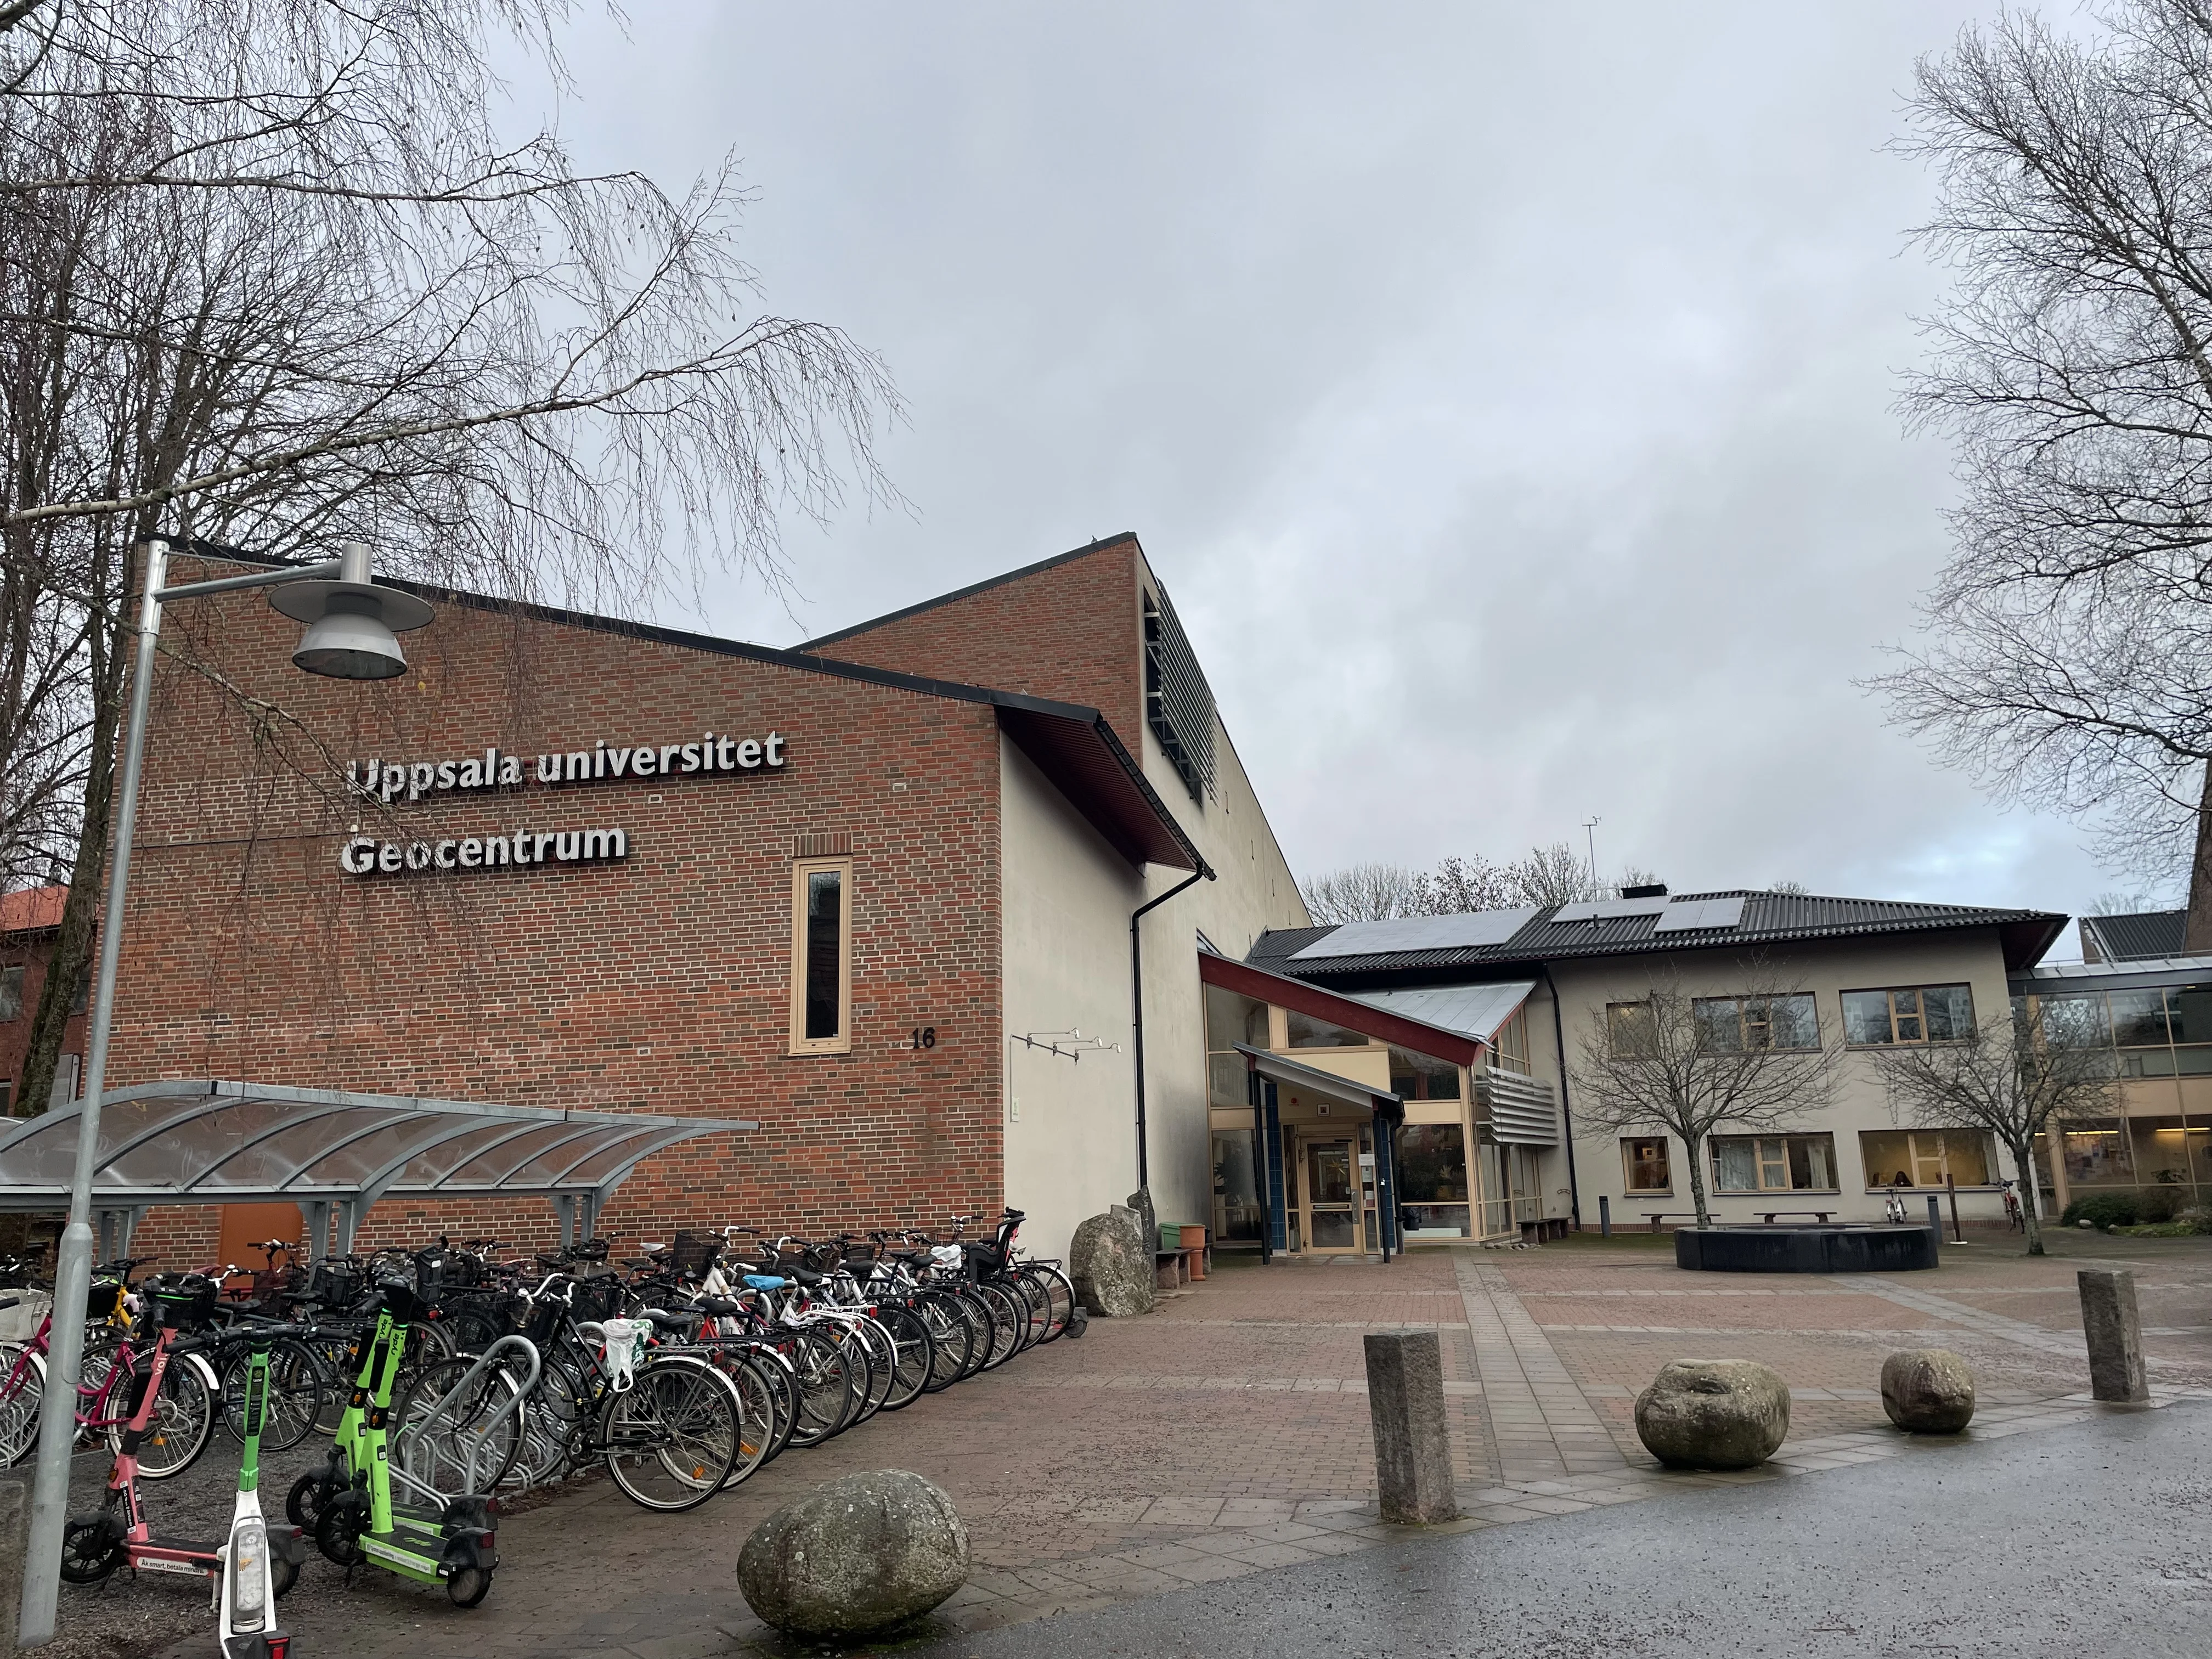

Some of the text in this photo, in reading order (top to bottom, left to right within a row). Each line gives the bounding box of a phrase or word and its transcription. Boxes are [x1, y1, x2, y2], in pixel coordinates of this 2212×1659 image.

[347, 730, 783, 802] Uppsala universitet
[341, 827, 625, 873] Geocentrum
[912, 1027, 935, 1049] 16
[379, 1319, 388, 1339] ryde
[391, 1333, 399, 1355] ryde
